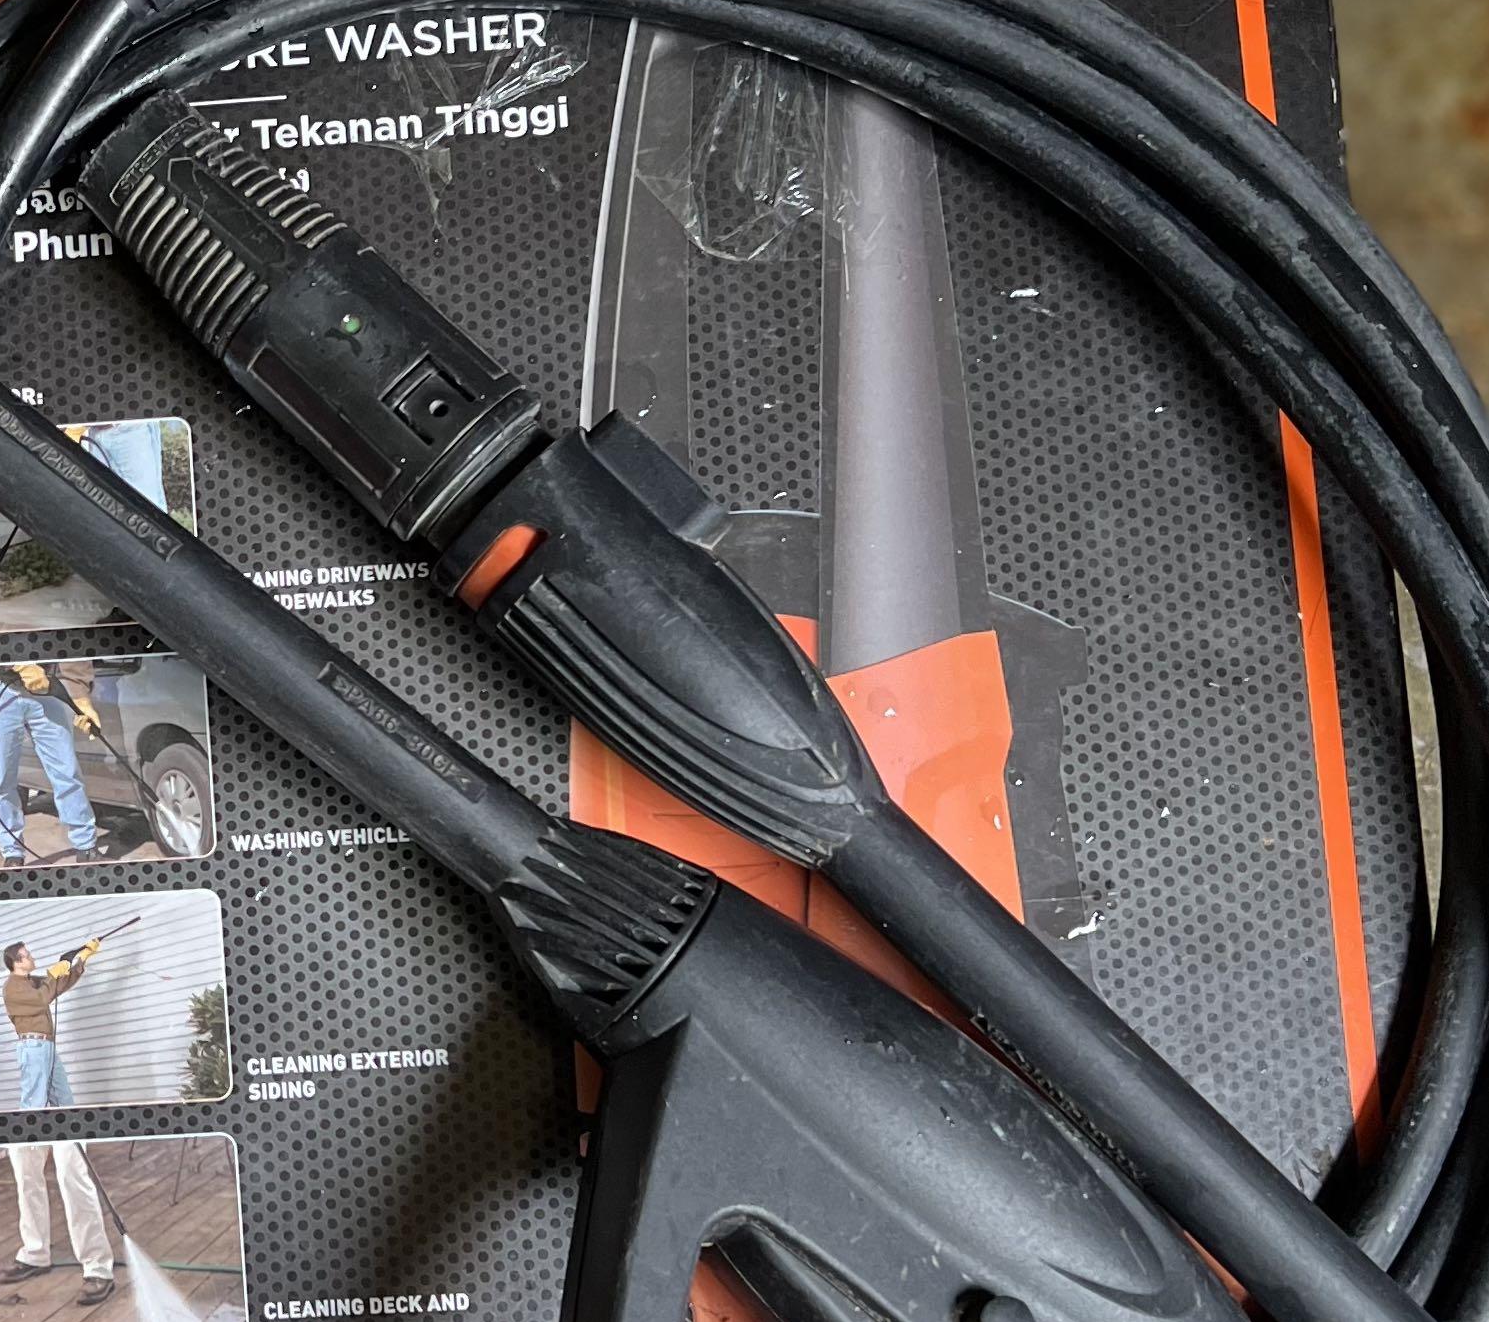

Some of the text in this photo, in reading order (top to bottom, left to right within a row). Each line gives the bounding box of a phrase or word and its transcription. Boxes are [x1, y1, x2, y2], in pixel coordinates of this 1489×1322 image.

[325, 12, 548, 63] WASHER
[251, 114, 422, 150] Tekanan
[435, 95, 569, 139] Tinggi
[13, 227, 113, 263] Phun
[243, 562, 430, 589] ANING DRIVEWAYS
[230, 830, 326, 853] WASHING
[247, 1048, 450, 1076] CLEANING EXTERIOR
[248, 1080, 316, 1101] SIDING
[263, 1292, 470, 1320] CLEANING DECK AND
